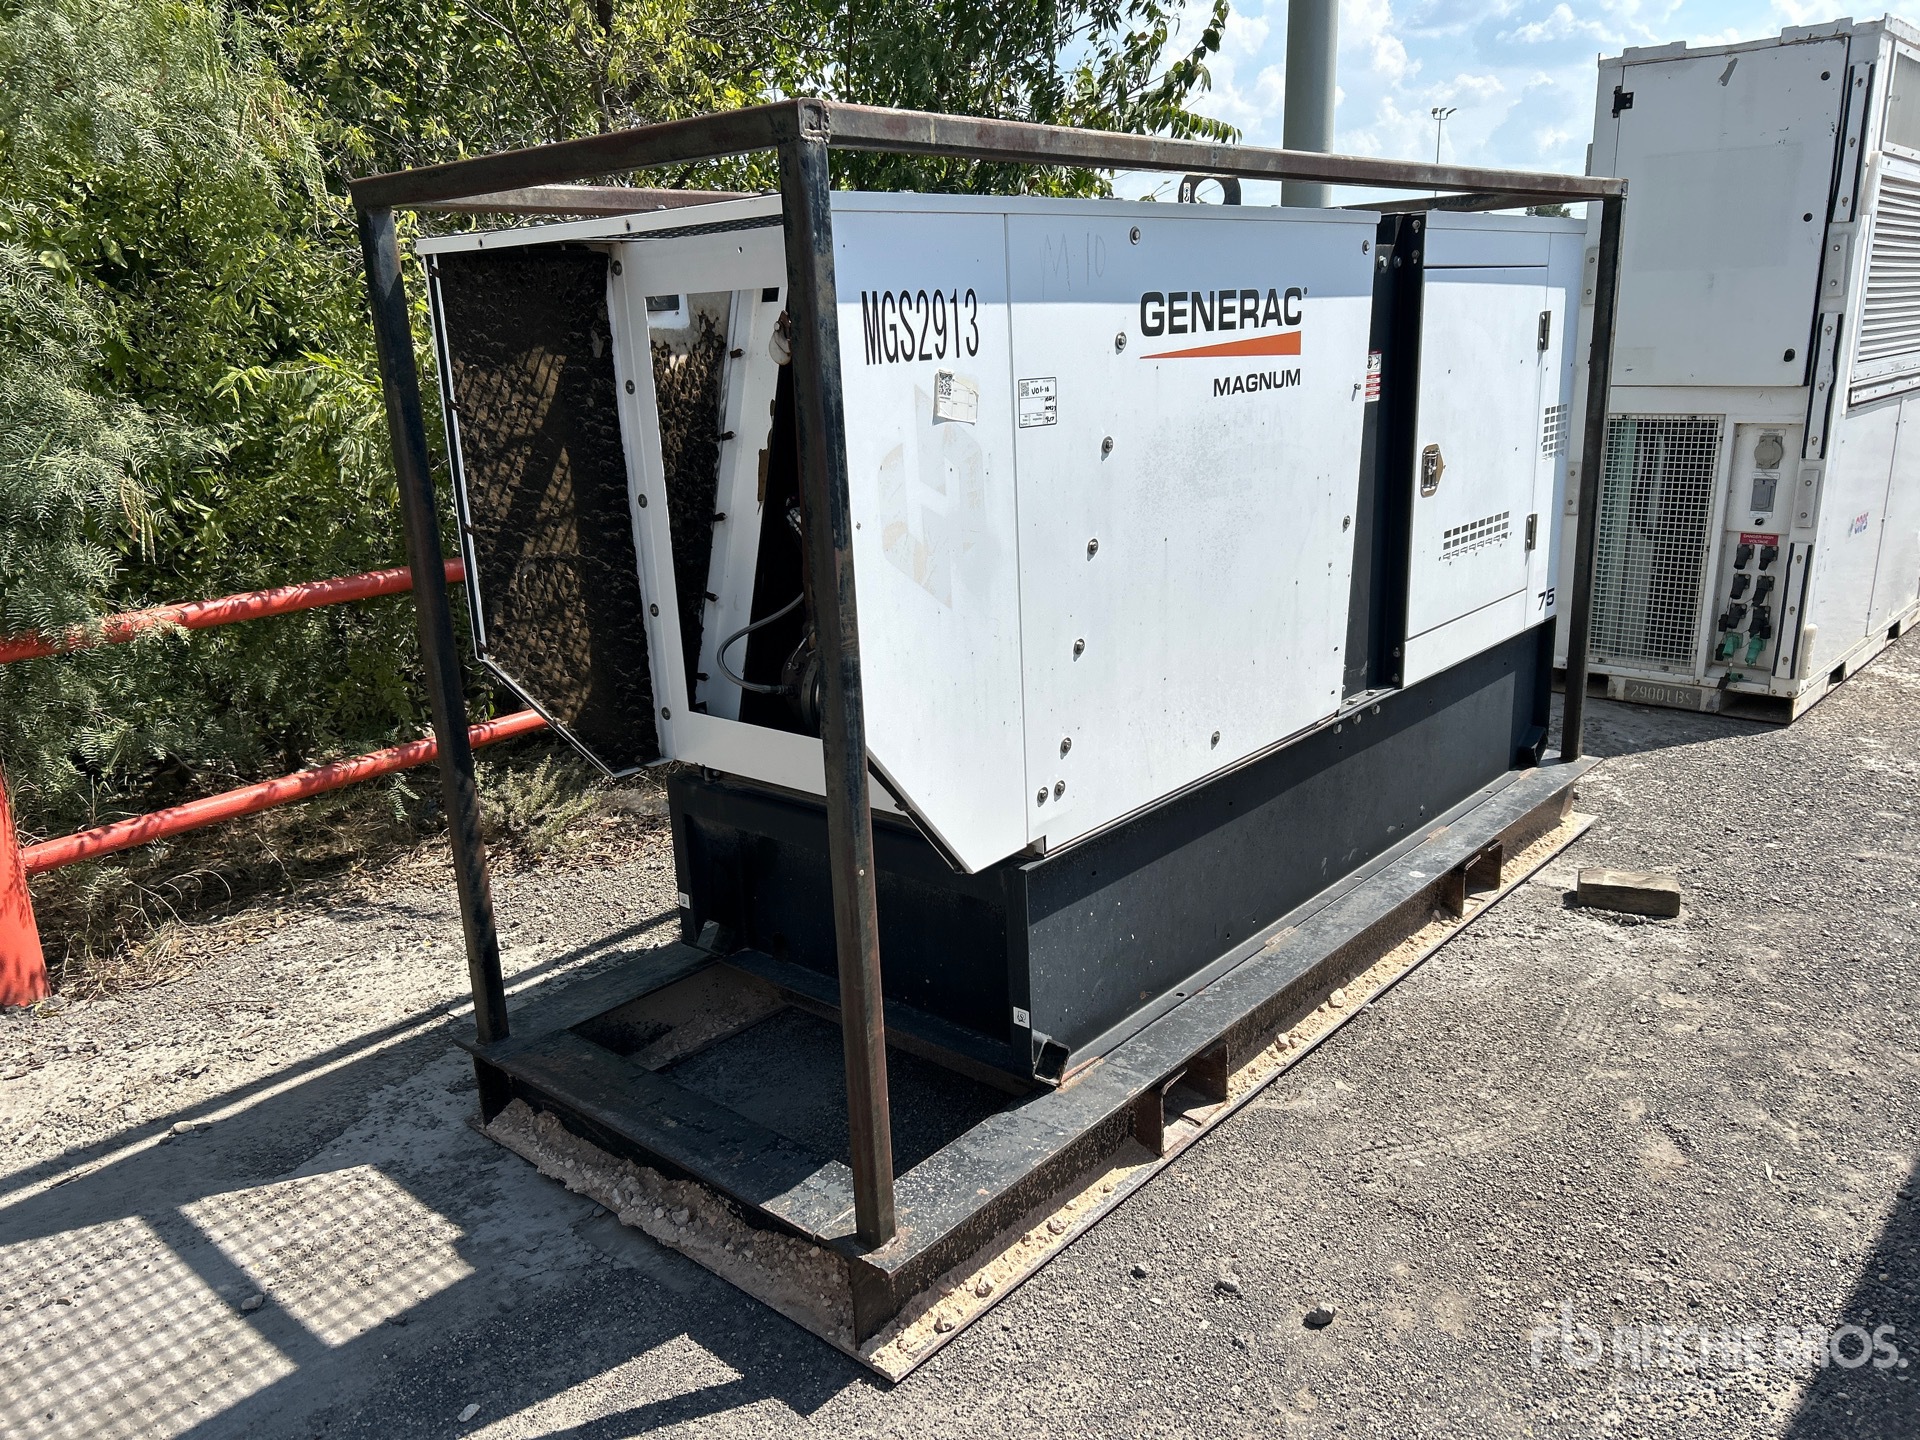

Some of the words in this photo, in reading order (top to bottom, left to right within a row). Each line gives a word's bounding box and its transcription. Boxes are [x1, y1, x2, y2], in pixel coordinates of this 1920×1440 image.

[861, 288, 979, 365] MGS2913
[1140, 287, 1302, 337] GENERAC
[1213, 368, 1301, 397] MAGNUM
[1538, 587, 1555, 611] 75
